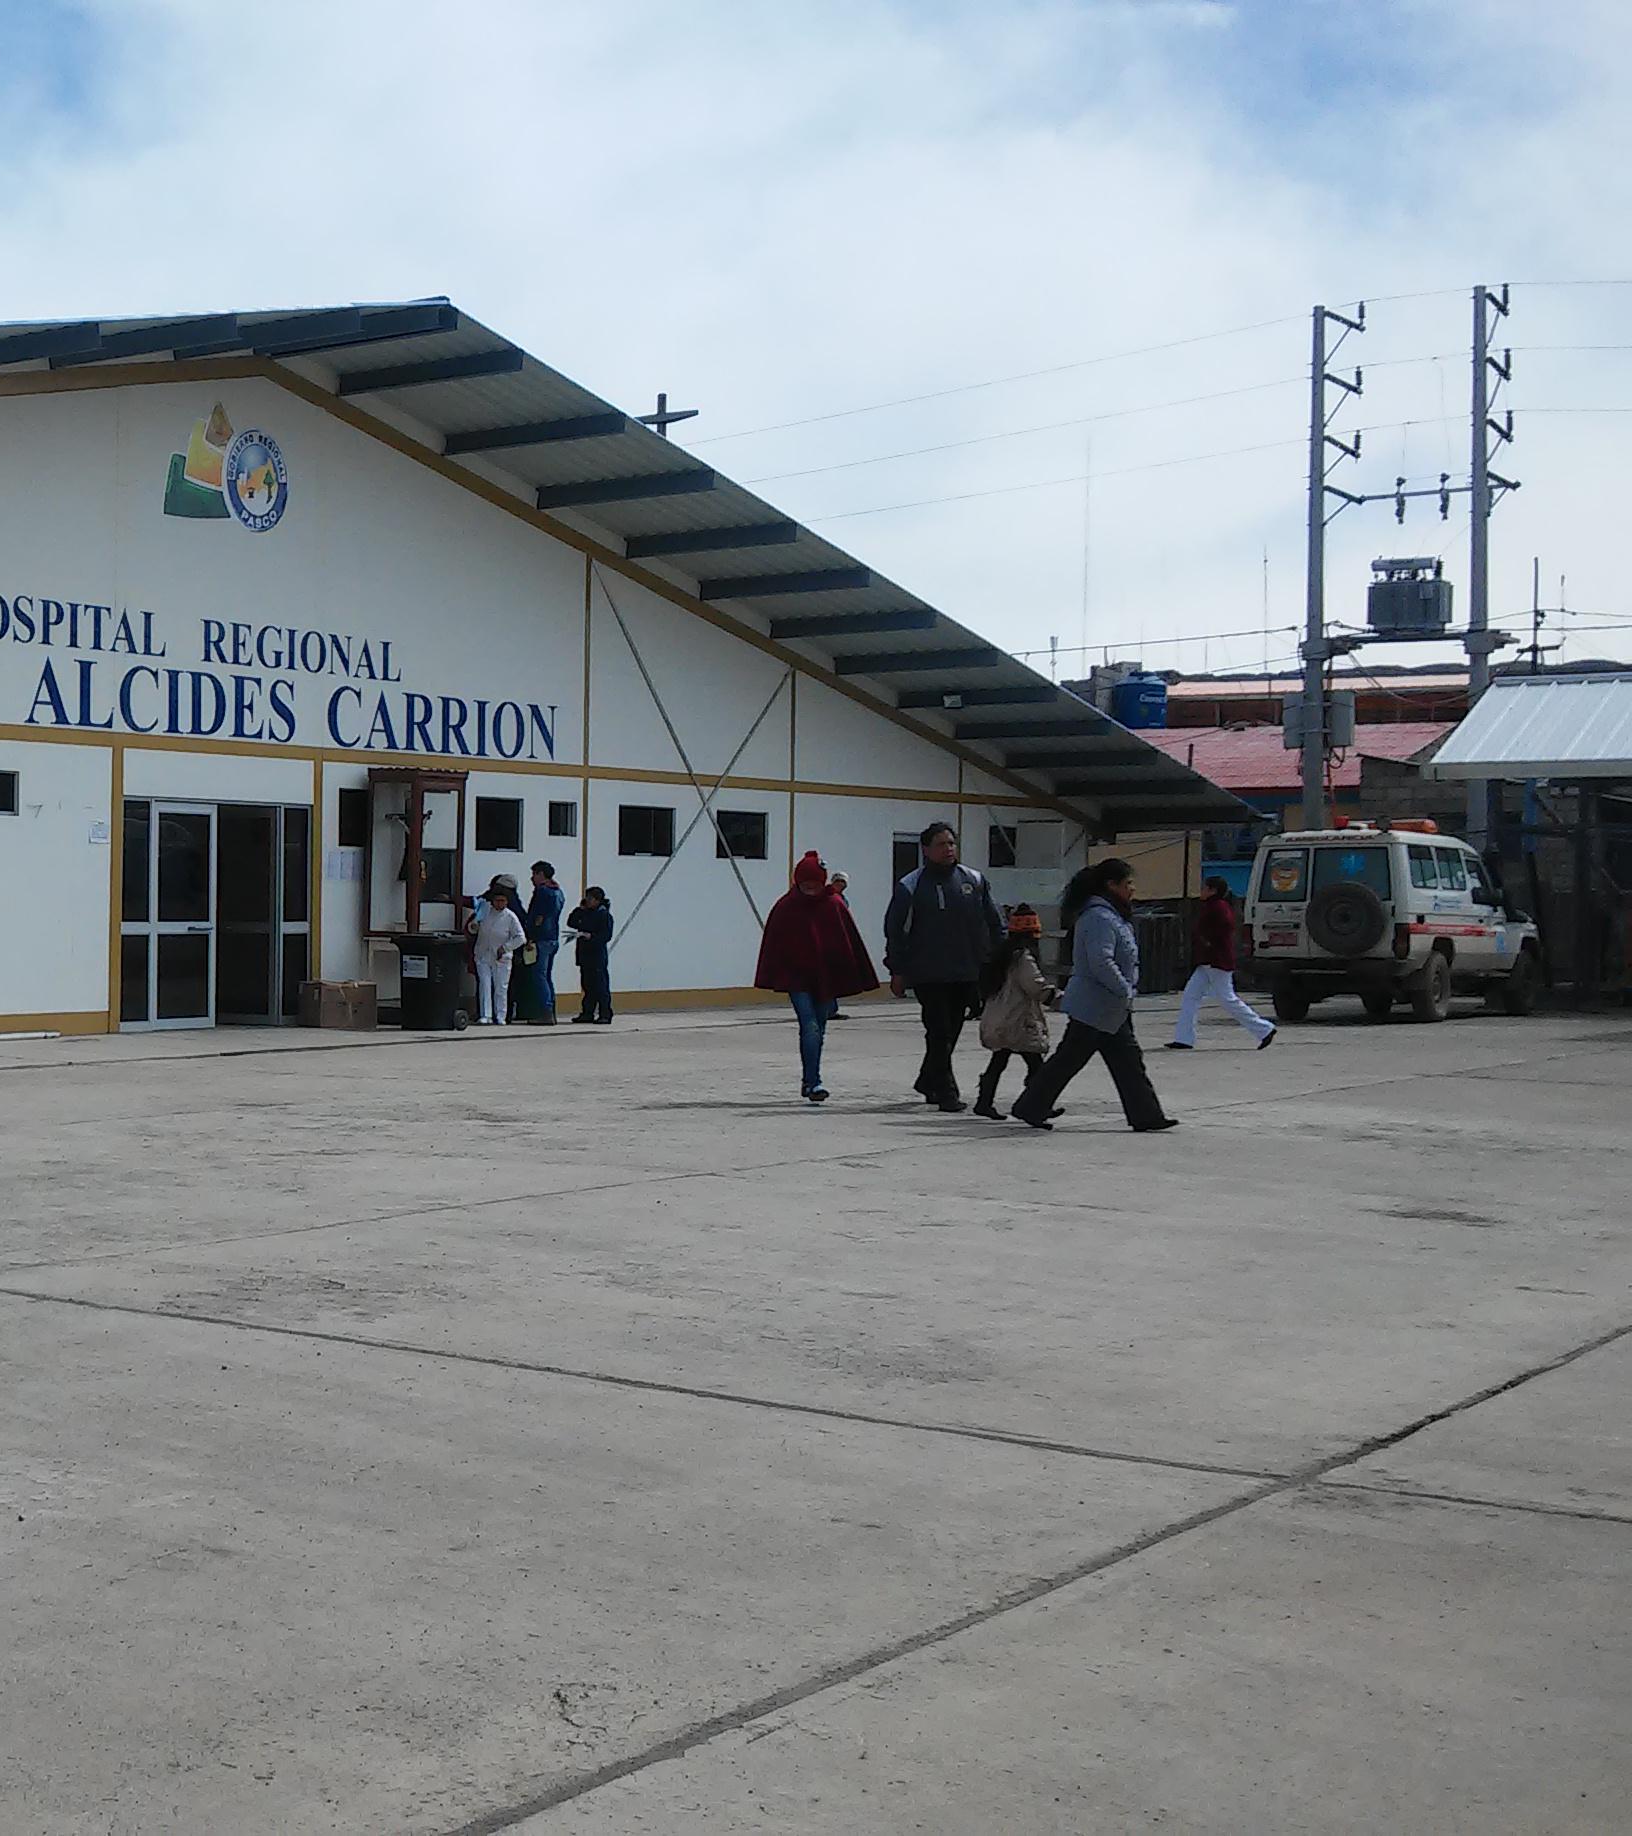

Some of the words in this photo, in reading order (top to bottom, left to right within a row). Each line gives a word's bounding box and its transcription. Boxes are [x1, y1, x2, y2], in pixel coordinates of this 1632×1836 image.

[228, 434, 254, 478] GOBIERNO
[258, 435, 285, 481] REGIONAL
[241, 510, 277, 528] PASCO
[200, 618, 401, 682] REGIONAL
[24, 655, 296, 743] ALCIDES
[327, 685, 558, 761] CARRION
